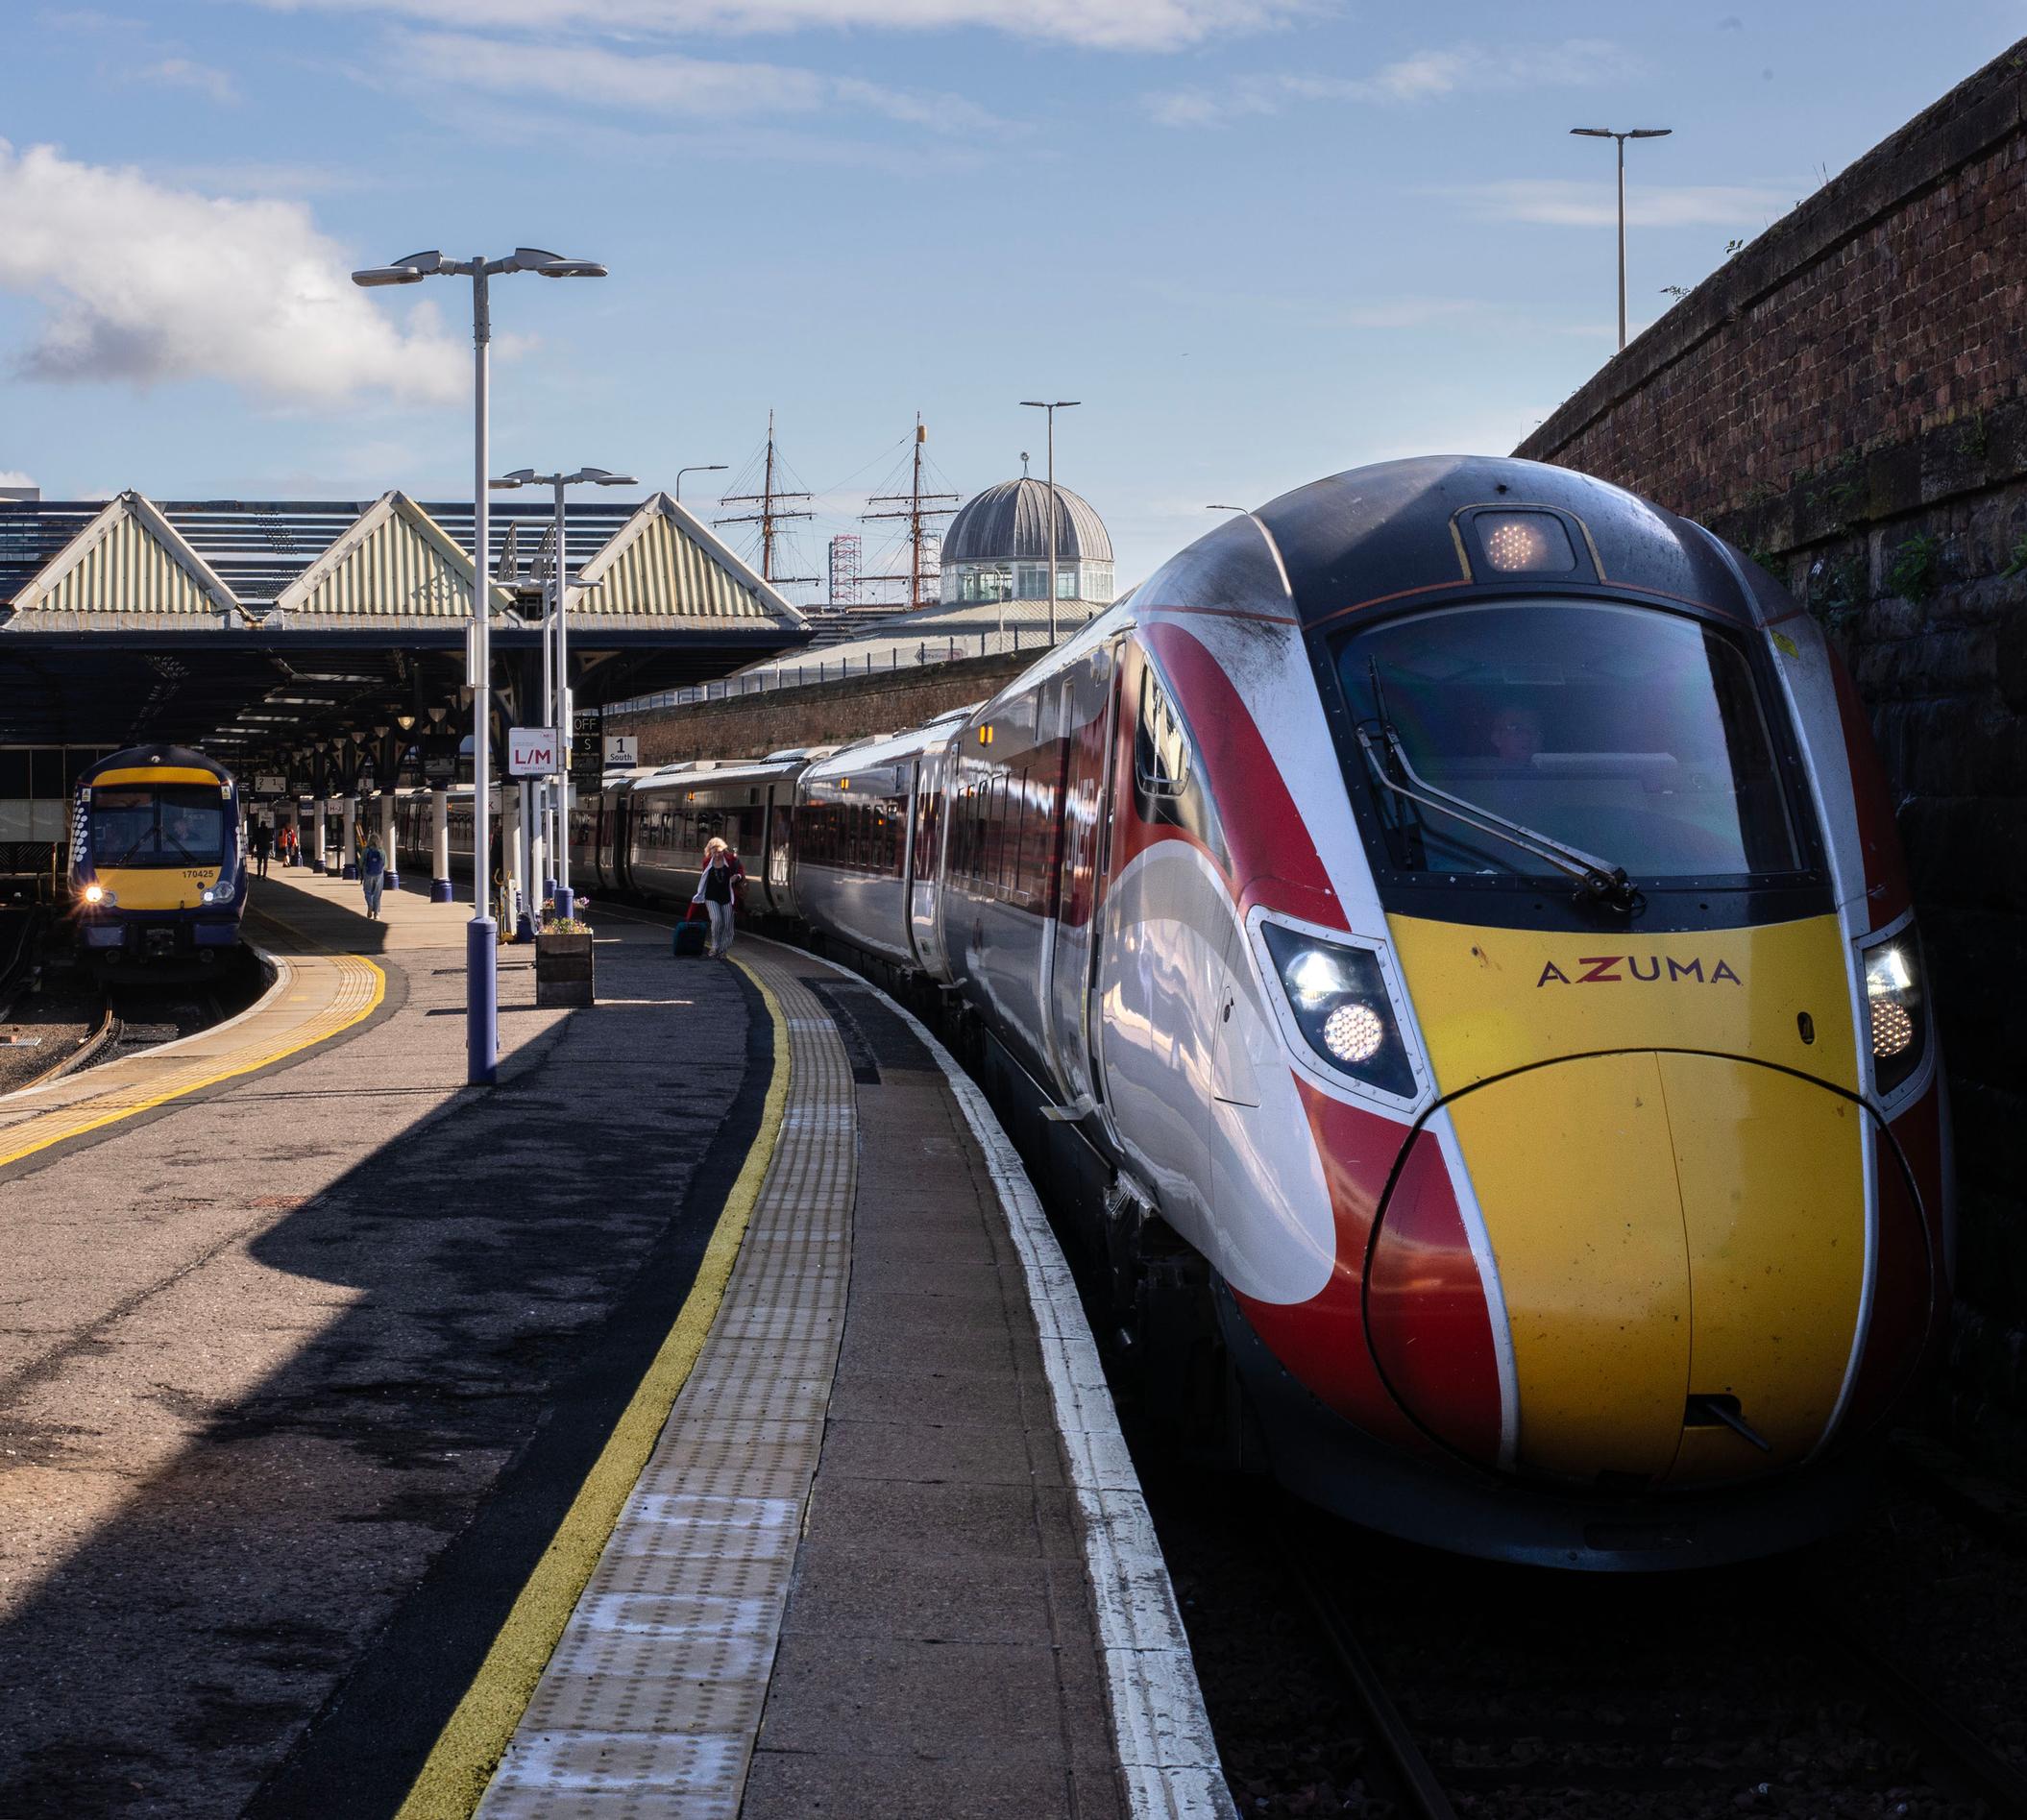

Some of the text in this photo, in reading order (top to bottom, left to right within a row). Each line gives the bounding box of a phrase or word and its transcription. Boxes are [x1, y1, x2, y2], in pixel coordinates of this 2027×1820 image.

[574, 718, 597, 730] OFF
[584, 738, 591, 750] S
[616, 738, 625, 753] 1
[515, 749, 550, 764] L/M
[183, 869, 213, 878] 170425
[1536, 956, 1741, 987] AZUMA
